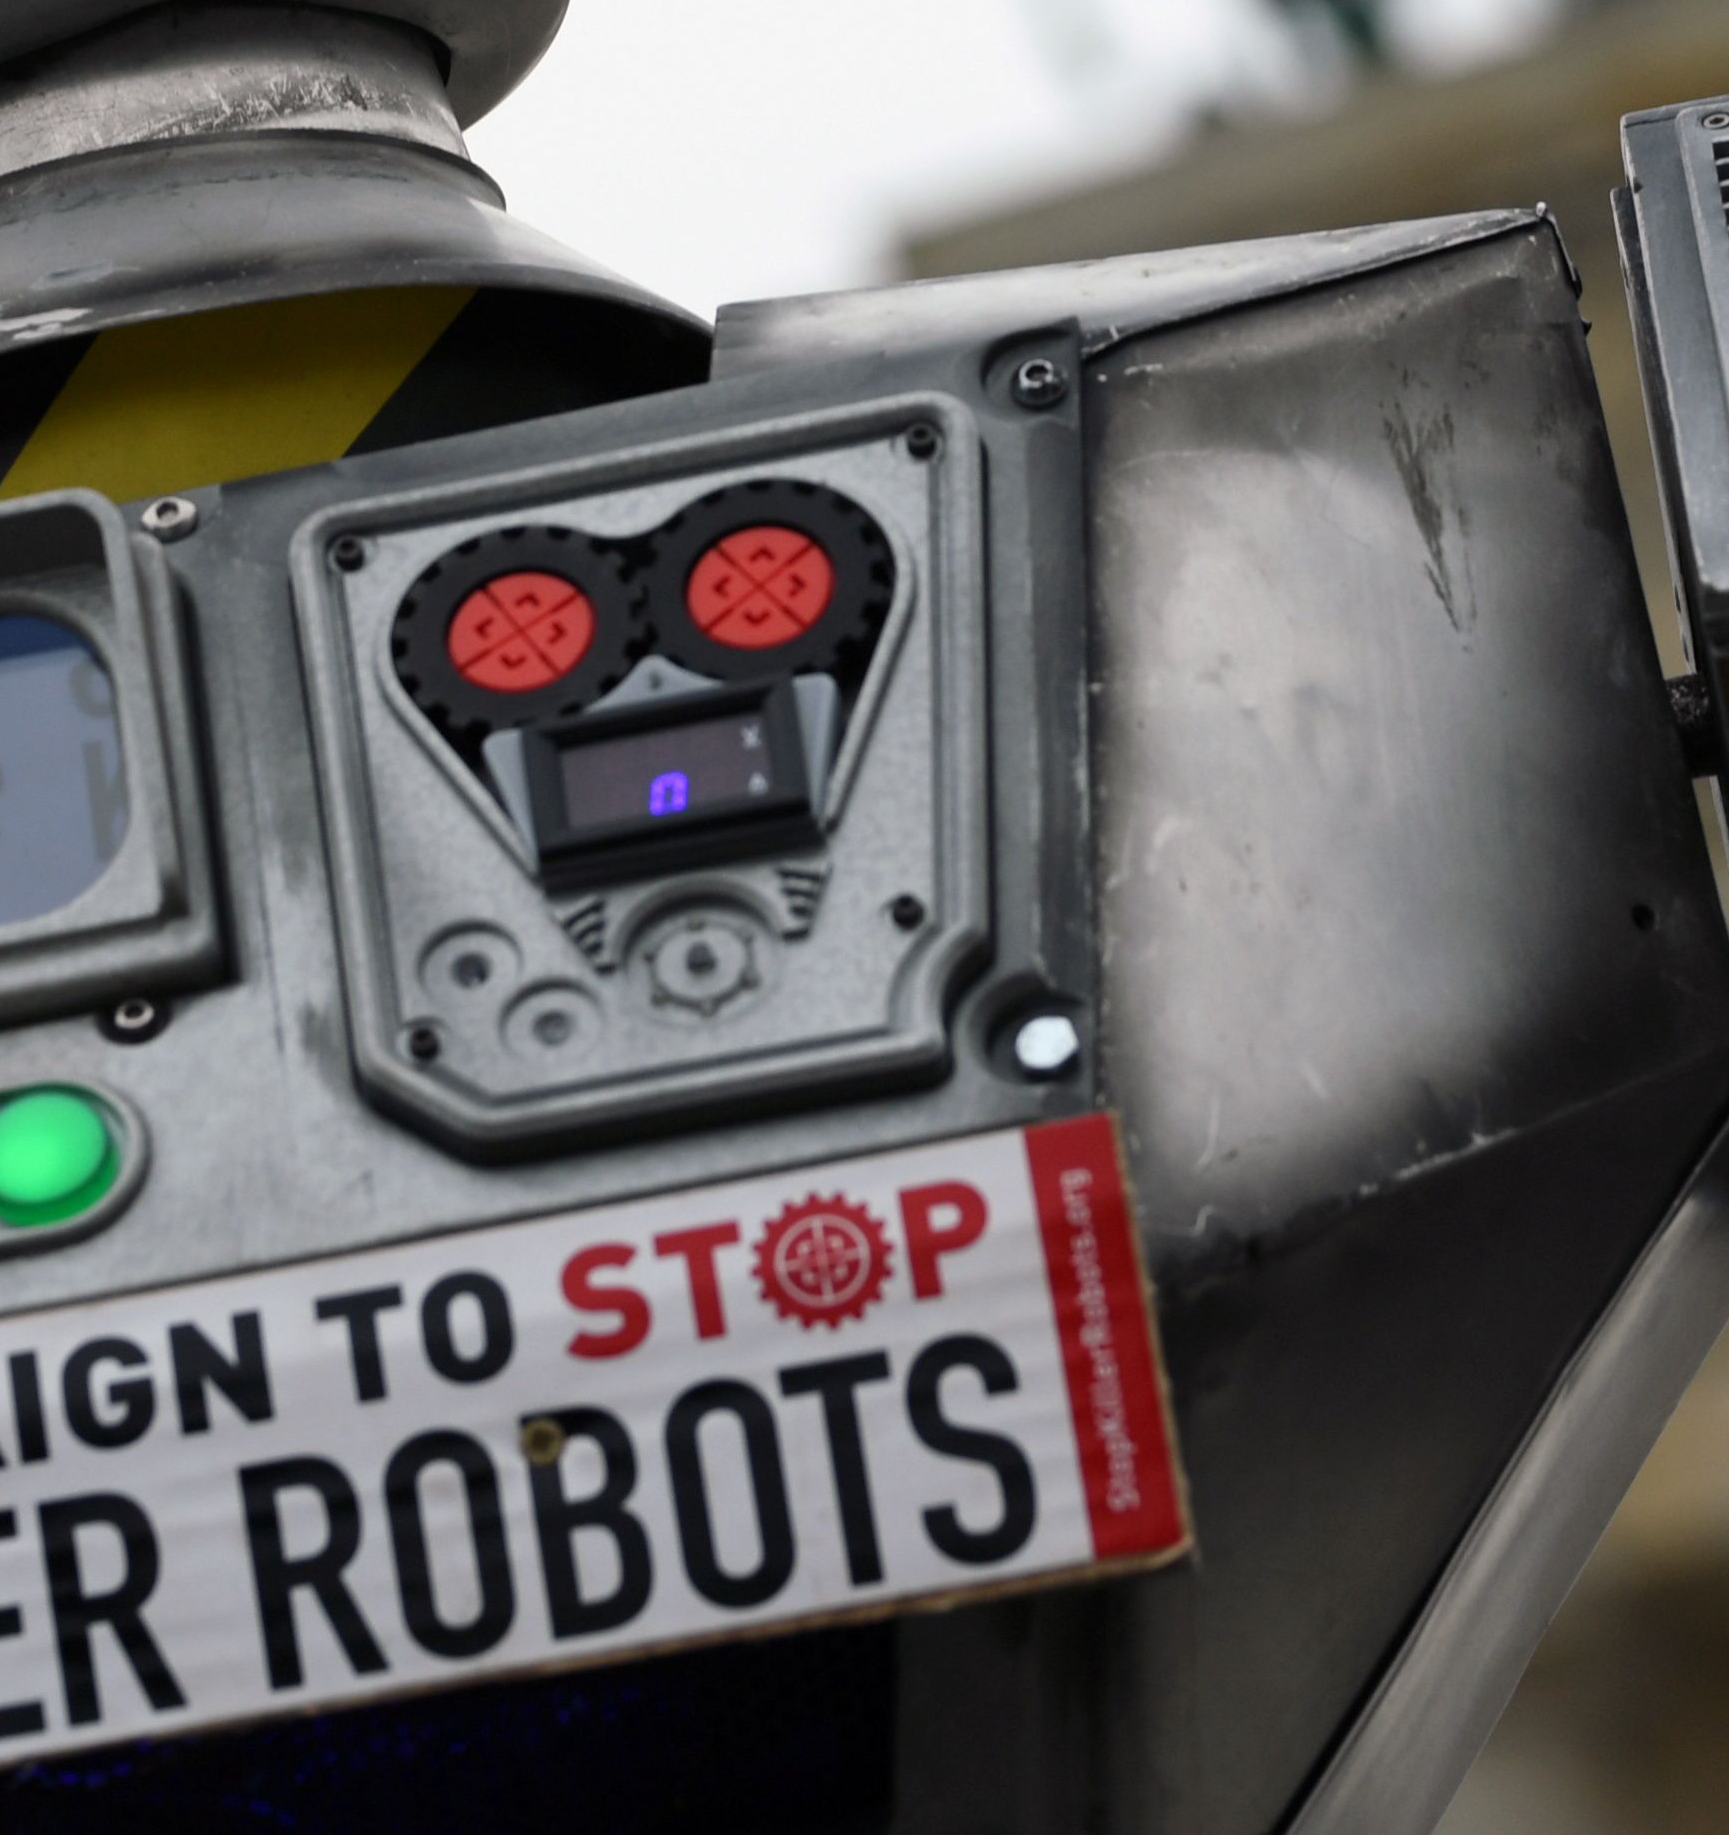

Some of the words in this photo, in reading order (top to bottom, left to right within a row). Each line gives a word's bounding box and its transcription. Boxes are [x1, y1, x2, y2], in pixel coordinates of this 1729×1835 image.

[316, 1272, 514, 1403] TO
[563, 1183, 986, 1358] STOP
[238, 1333, 1037, 1691] ROBOTS
